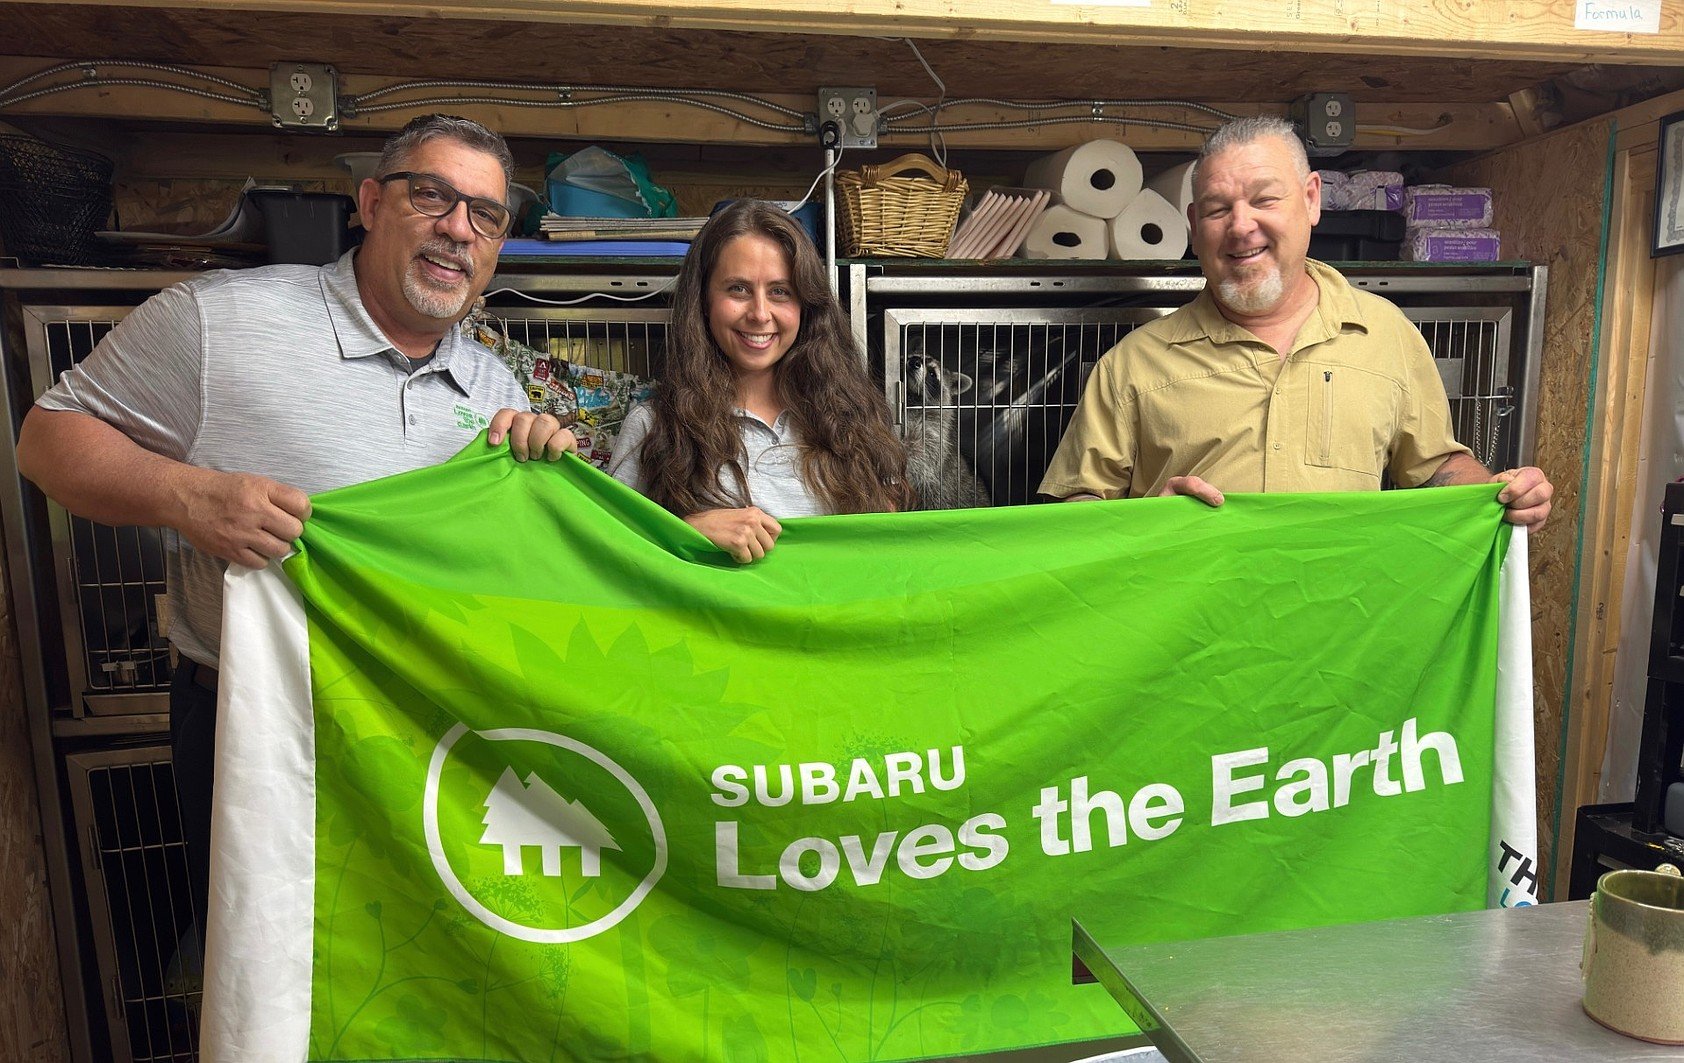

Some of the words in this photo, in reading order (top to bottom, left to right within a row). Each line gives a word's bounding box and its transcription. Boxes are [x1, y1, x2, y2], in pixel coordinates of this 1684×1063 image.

[1585, 3, 1643, 20] Formula
[710, 745, 967, 808] SUBARU
[714, 811, 1010, 892] Loves
[1032, 775, 1185, 856] the
[1210, 717, 1465, 827] Earth
